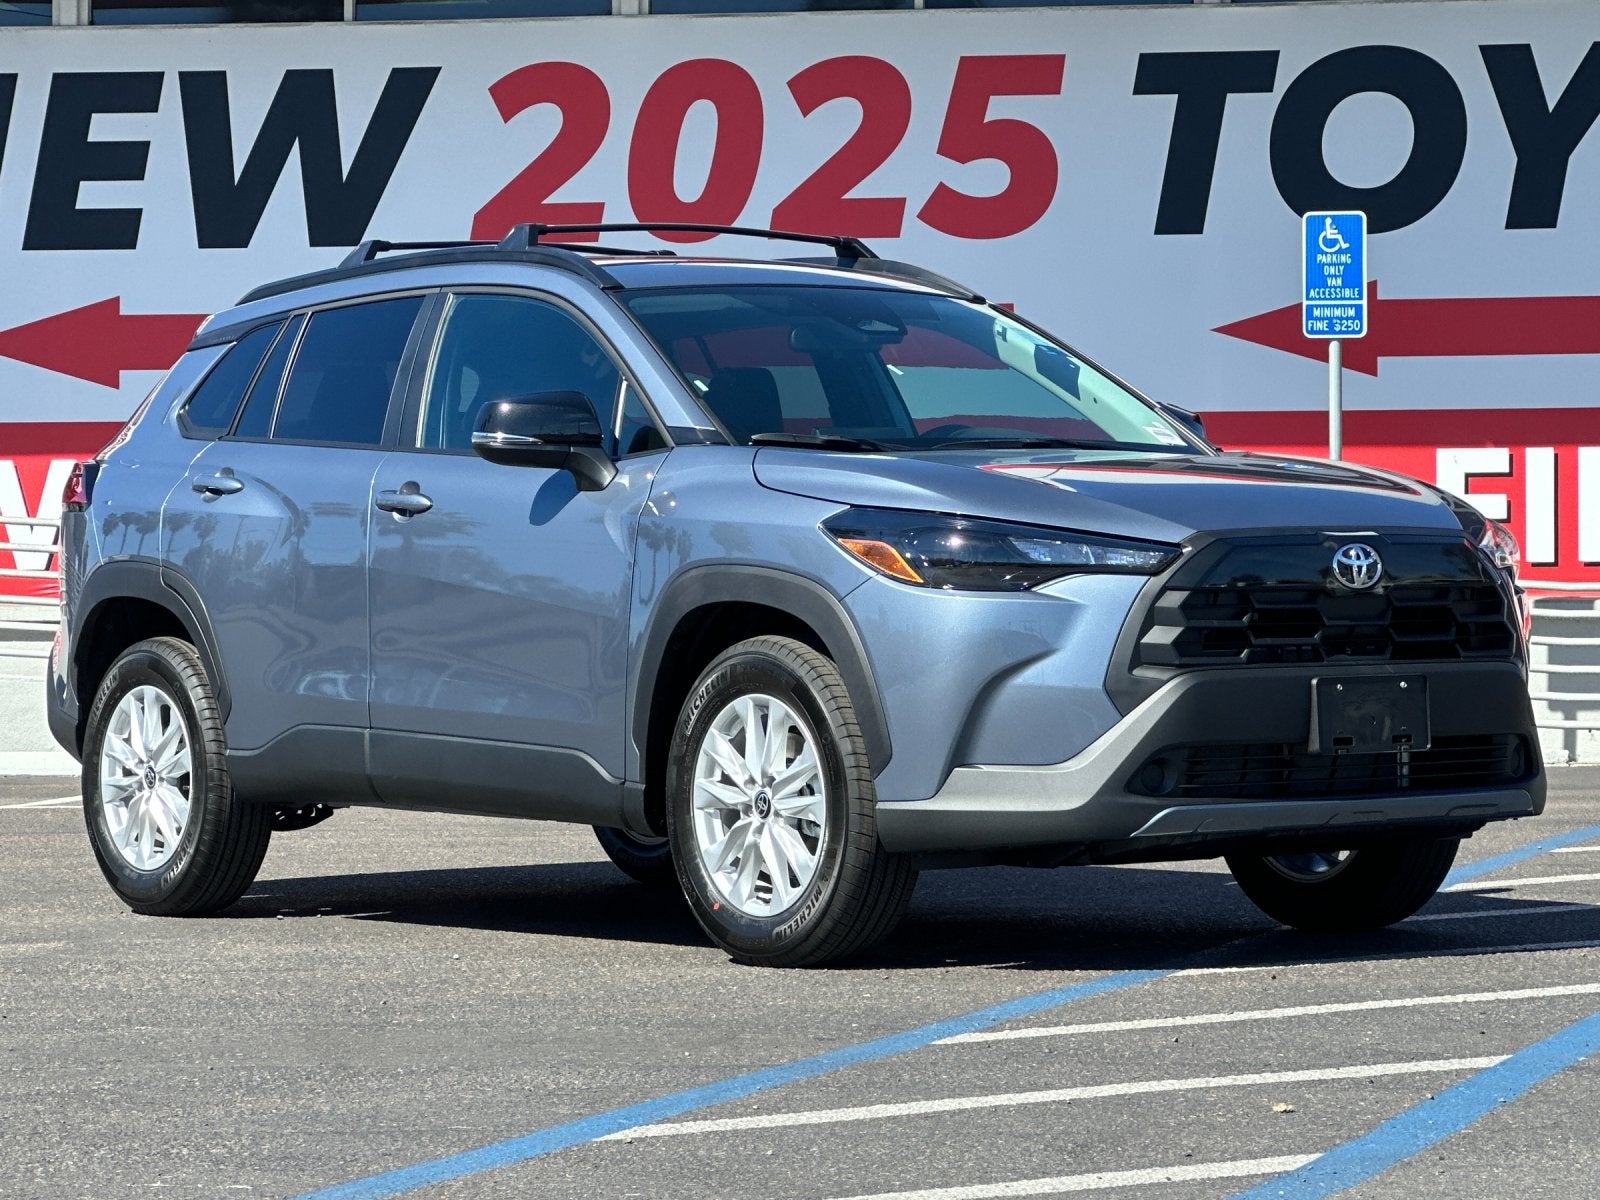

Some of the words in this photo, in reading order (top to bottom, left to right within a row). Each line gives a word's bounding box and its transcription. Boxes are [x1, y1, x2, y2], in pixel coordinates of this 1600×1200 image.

[0, 67, 442, 250] EW
[471, 54, 1066, 243] 2025
[1133, 41, 1600, 235] TOY
[1316, 253, 1352, 264] PARKING
[1323, 265, 1345, 276] ONLY
[1326, 276, 1342, 287] VAN
[1308, 287, 1360, 299] ACCESSIBLE
[1313, 306, 1356, 318] MINIMUM
[1307, 319, 1330, 331] FINE
[1333, 319, 1360, 332] $250
[683, 669, 730, 731] MICHELIN
[774, 885, 823, 944] MICHELIN
